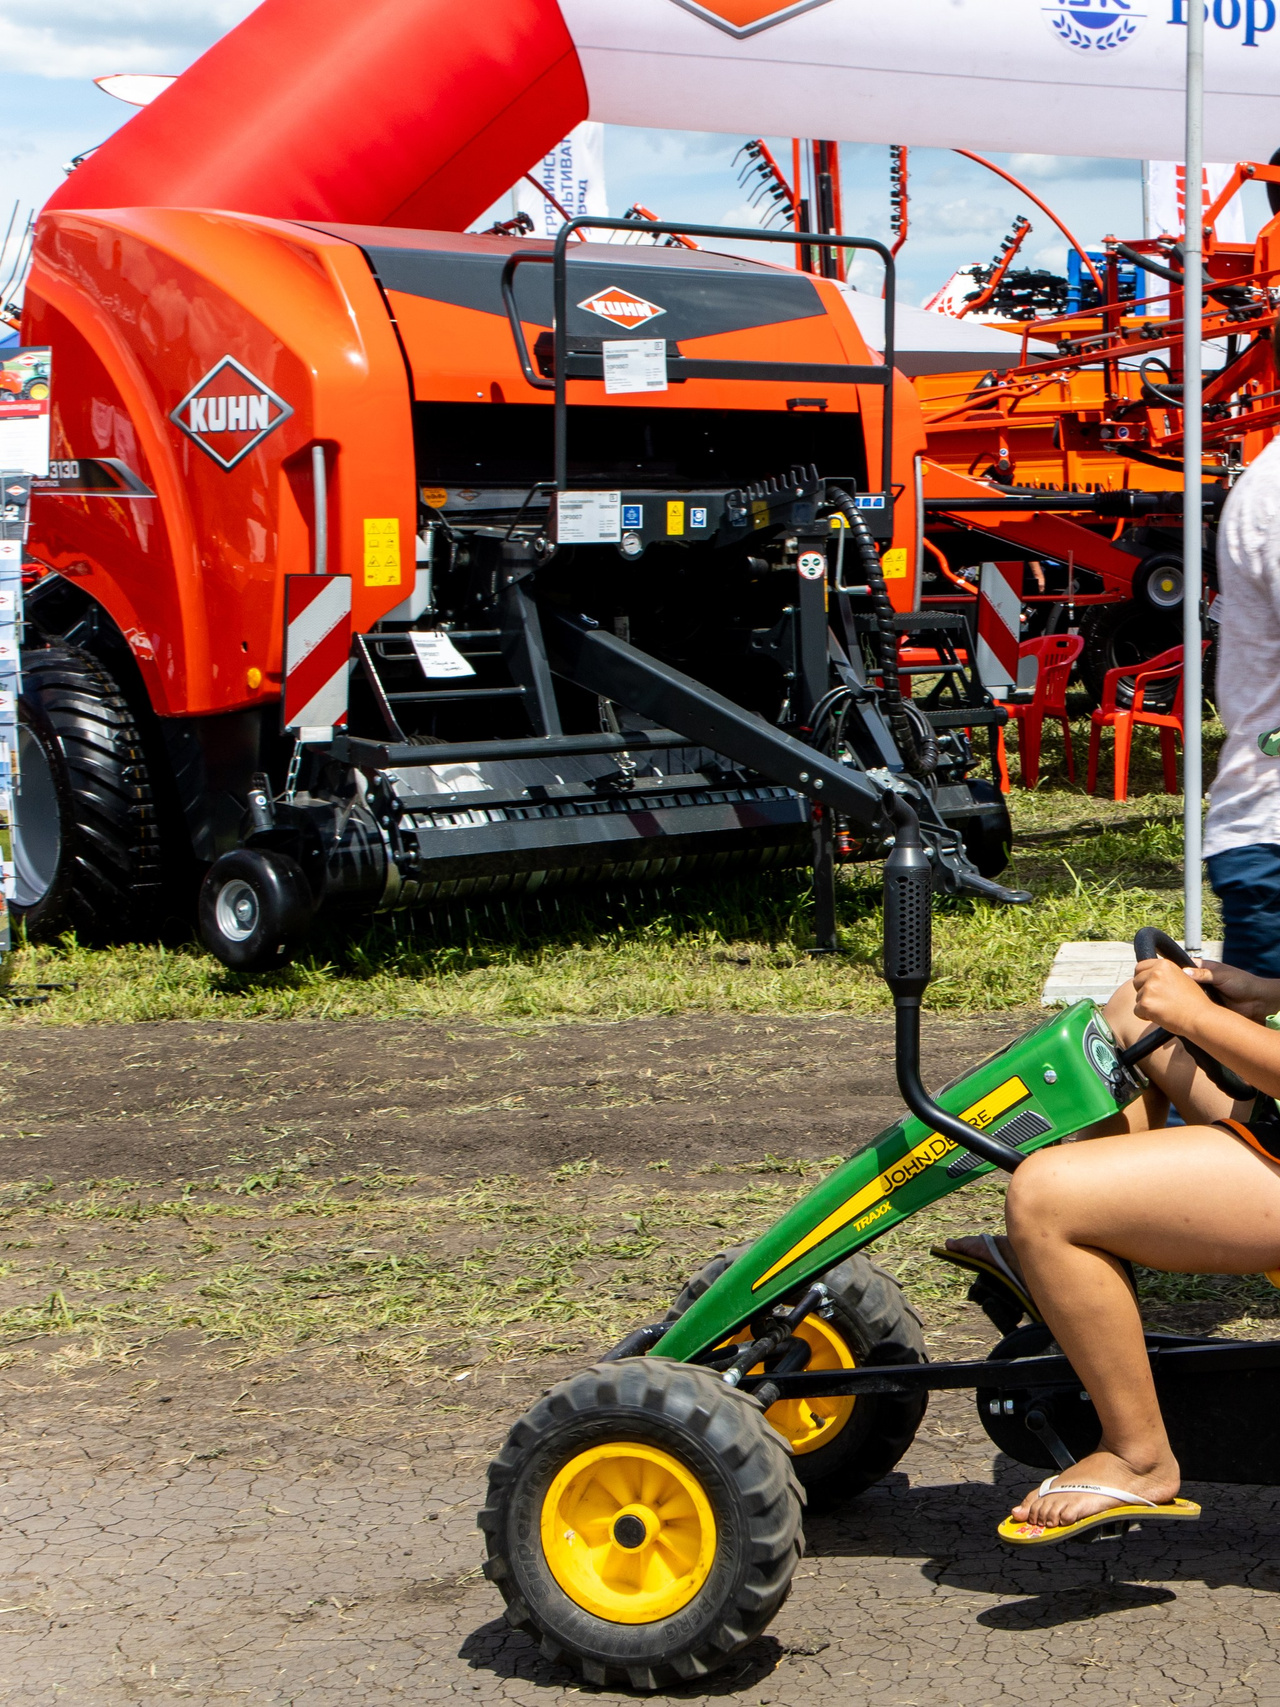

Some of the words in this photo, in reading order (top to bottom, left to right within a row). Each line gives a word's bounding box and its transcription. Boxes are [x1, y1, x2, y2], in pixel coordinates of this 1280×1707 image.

[591, 300, 653, 317] KUHN
[190, 394, 269, 433] KUHN
[883, 1151, 932, 1193] JOHN
[929, 1109, 992, 1157] DERE
[853, 1201, 893, 1232] TRAXX
